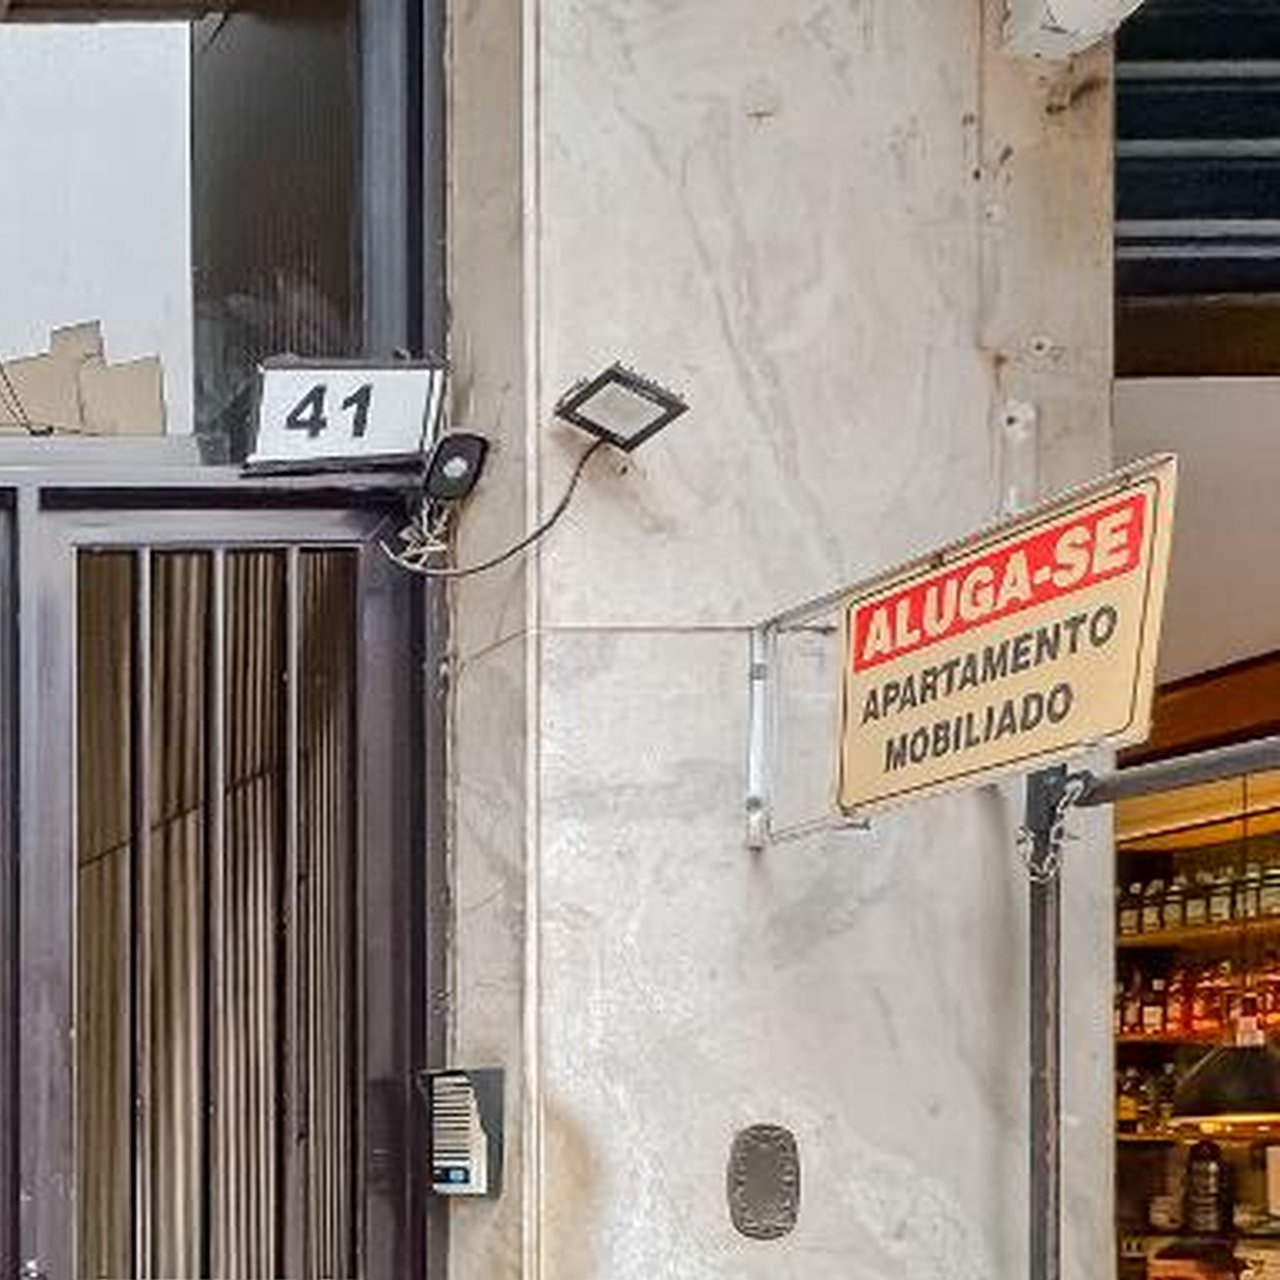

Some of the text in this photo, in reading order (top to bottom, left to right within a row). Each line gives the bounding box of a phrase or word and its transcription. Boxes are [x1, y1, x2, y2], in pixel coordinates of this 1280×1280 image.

[286, 383, 373, 438] 41
[862, 505, 1135, 660] ALUGA-SE
[860, 605, 1119, 726] APARTAMENTO
[883, 682, 1075, 774] MOBILIADO
